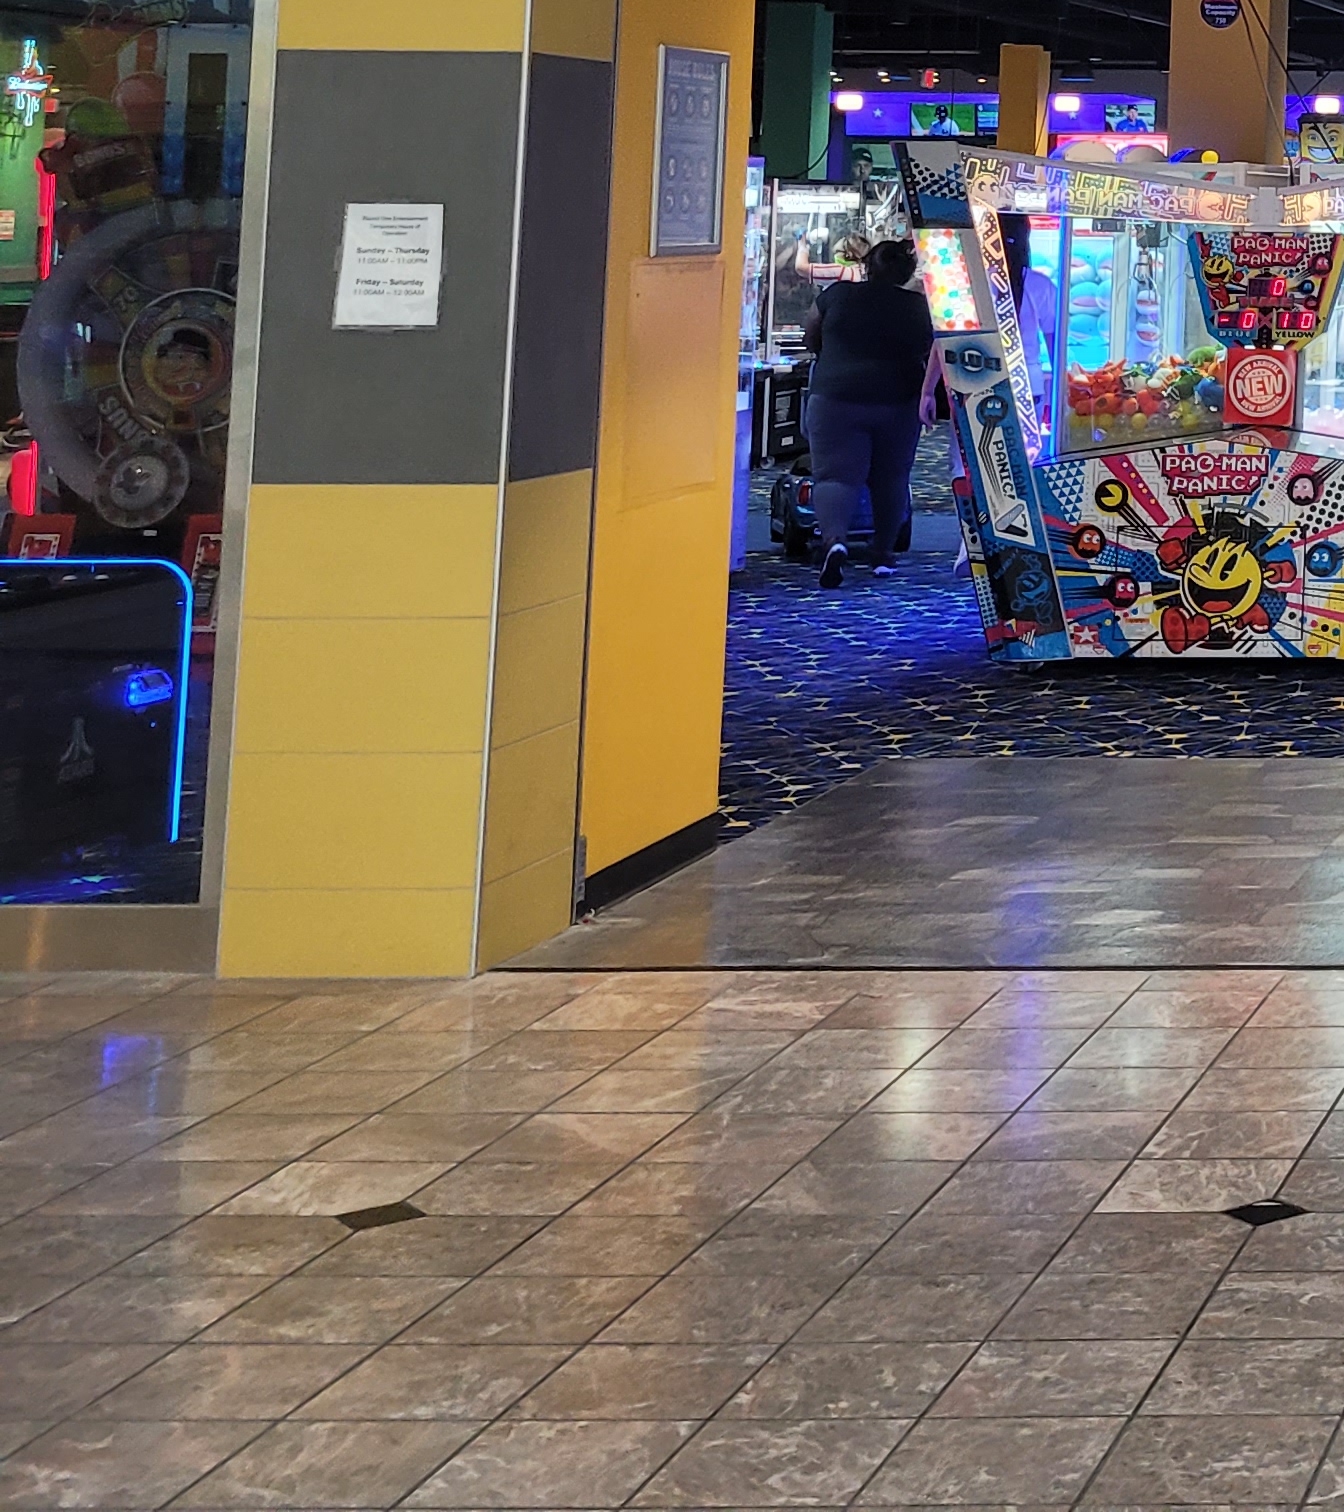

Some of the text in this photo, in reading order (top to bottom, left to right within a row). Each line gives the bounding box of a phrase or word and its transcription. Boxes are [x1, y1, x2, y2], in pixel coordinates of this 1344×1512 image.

[395, 247, 430, 255] Thursday
[1233, 237, 1307, 251] PAC-MAN
[1238, 252, 1300, 265] PANIC!
[356, 279, 381, 287] Friday
[389, 279, 424, 287] Saturday
[1275, 330, 1315, 338] YELLOW
[1235, 374, 1283, 399] NEW
[993, 439, 1016, 500] PANIC!
[1165, 454, 1267, 473] PAC-MAN
[1172, 475, 1260, 493] PANIC!
